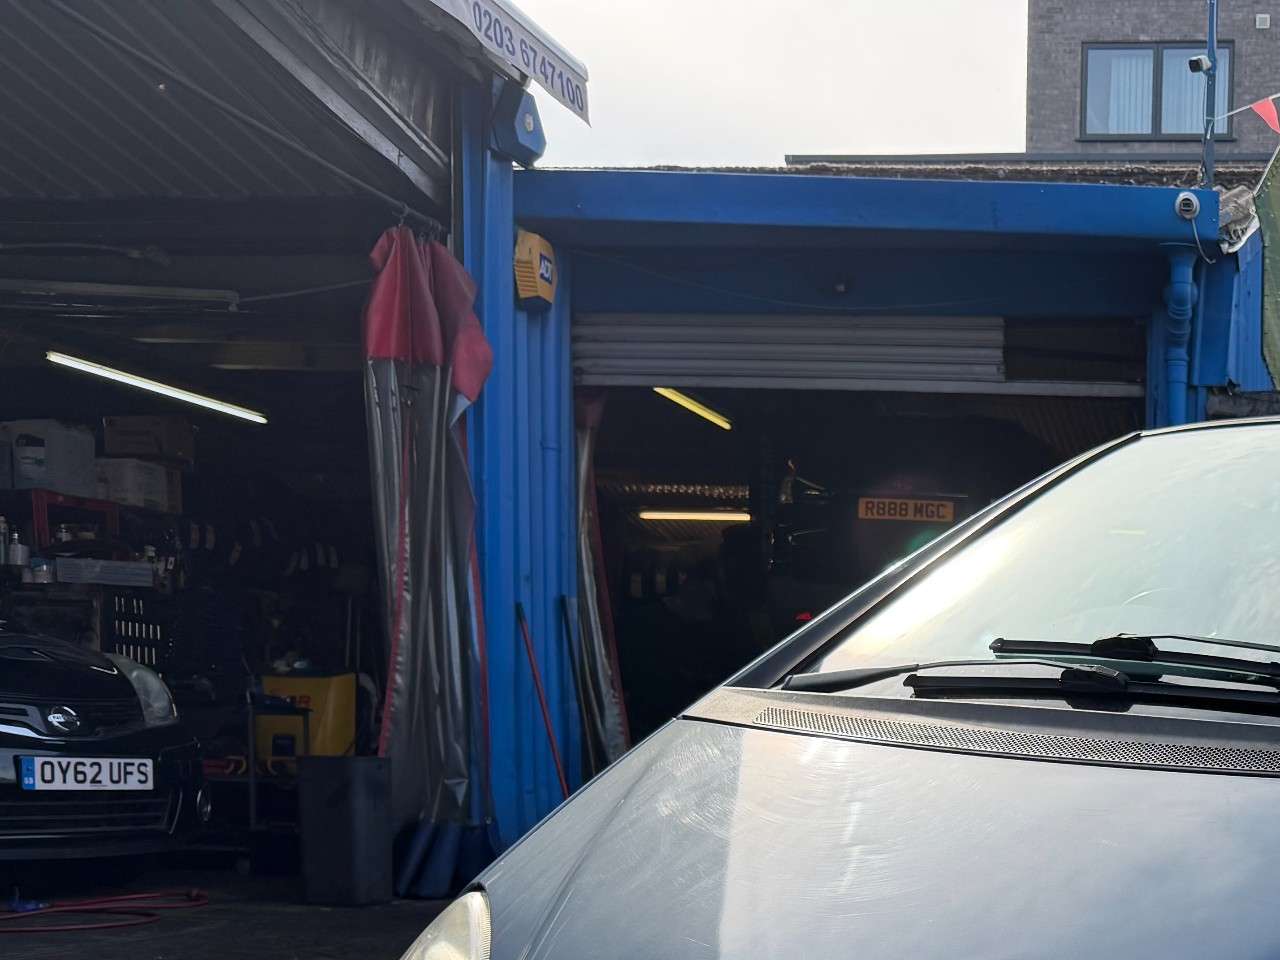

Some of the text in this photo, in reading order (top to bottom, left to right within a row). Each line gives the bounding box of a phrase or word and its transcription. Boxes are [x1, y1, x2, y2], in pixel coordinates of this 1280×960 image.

[472, 1, 585, 112] 0203 6747100
[40, 760, 149, 785] OY62 UFS
